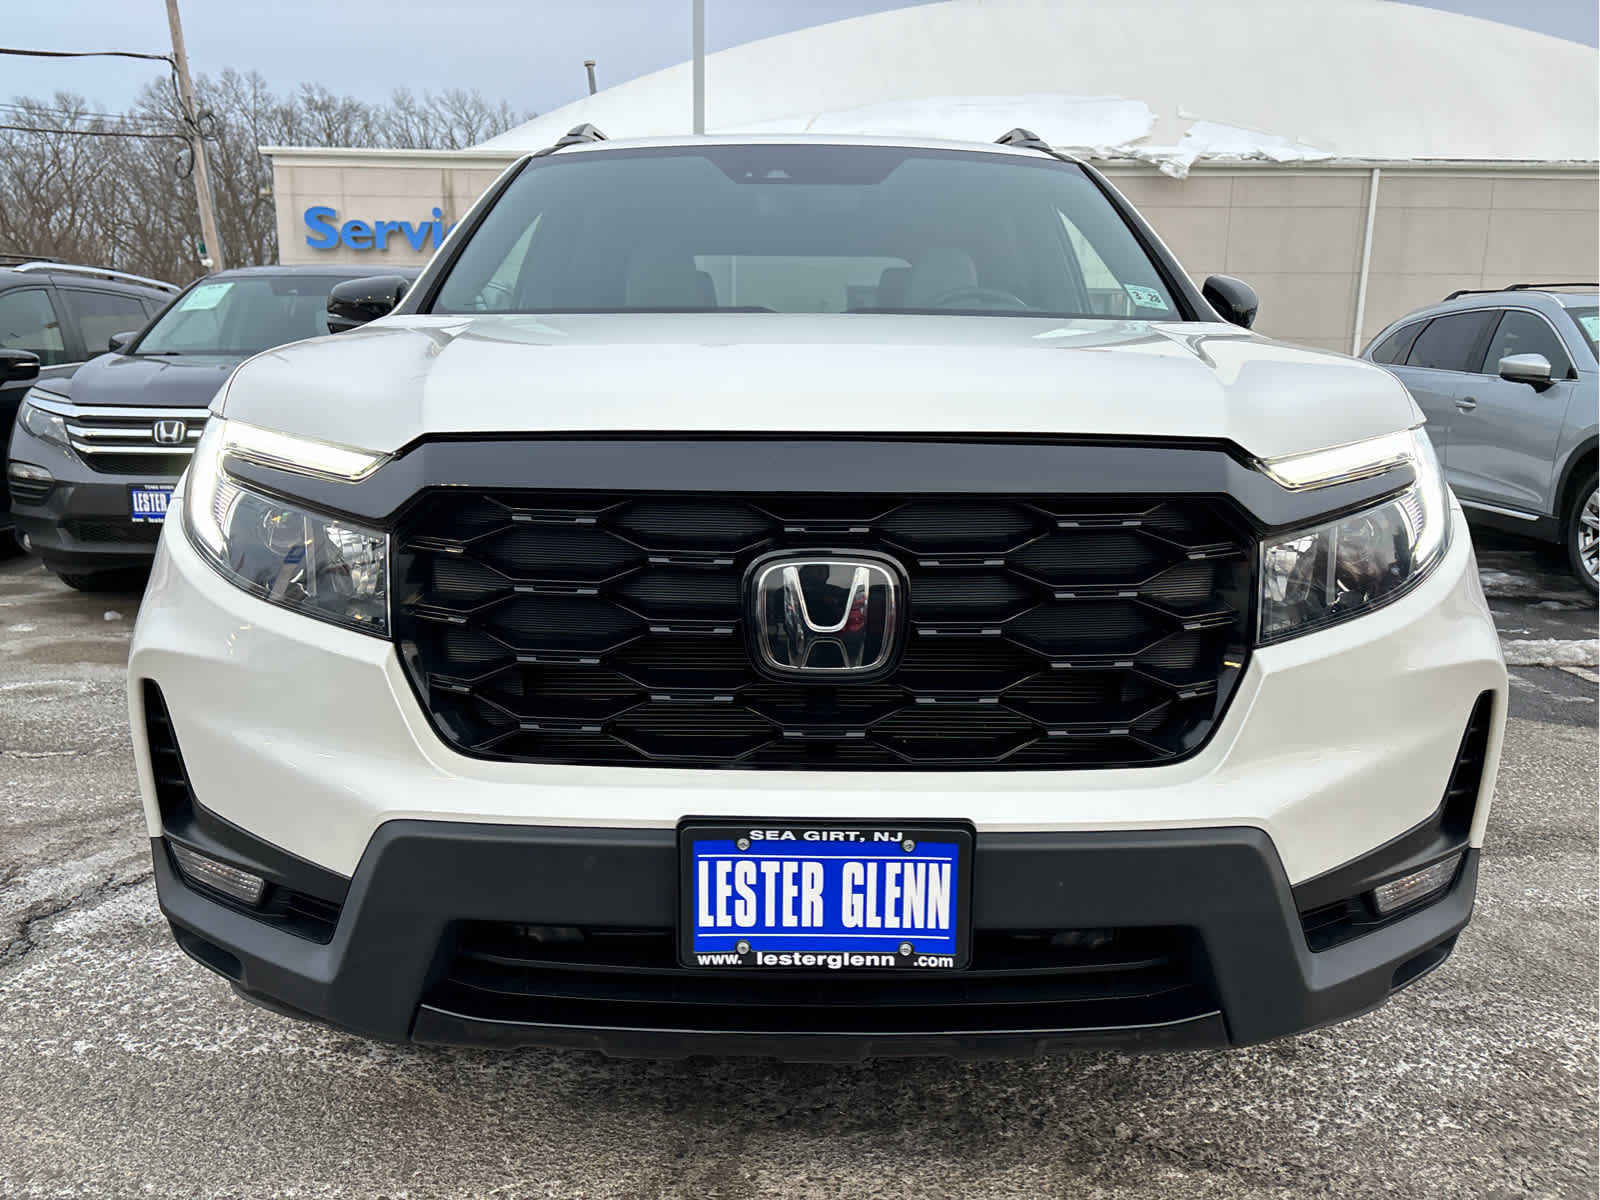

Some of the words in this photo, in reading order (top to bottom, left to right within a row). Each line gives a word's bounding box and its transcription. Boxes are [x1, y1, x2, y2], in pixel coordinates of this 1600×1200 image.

[303, 205, 457, 251] Servi
[132, 491, 168, 512] LESTER
[749, 829, 796, 841] SEA
[803, 830, 866, 843] GIRT,
[873, 832, 904, 842] NJ
[697, 860, 824, 928] LESTER
[841, 862, 952, 929] GLENN
[697, 955, 742, 965] www.
[756, 951, 895, 969] lesterglenn
[913, 955, 953, 968] .com
